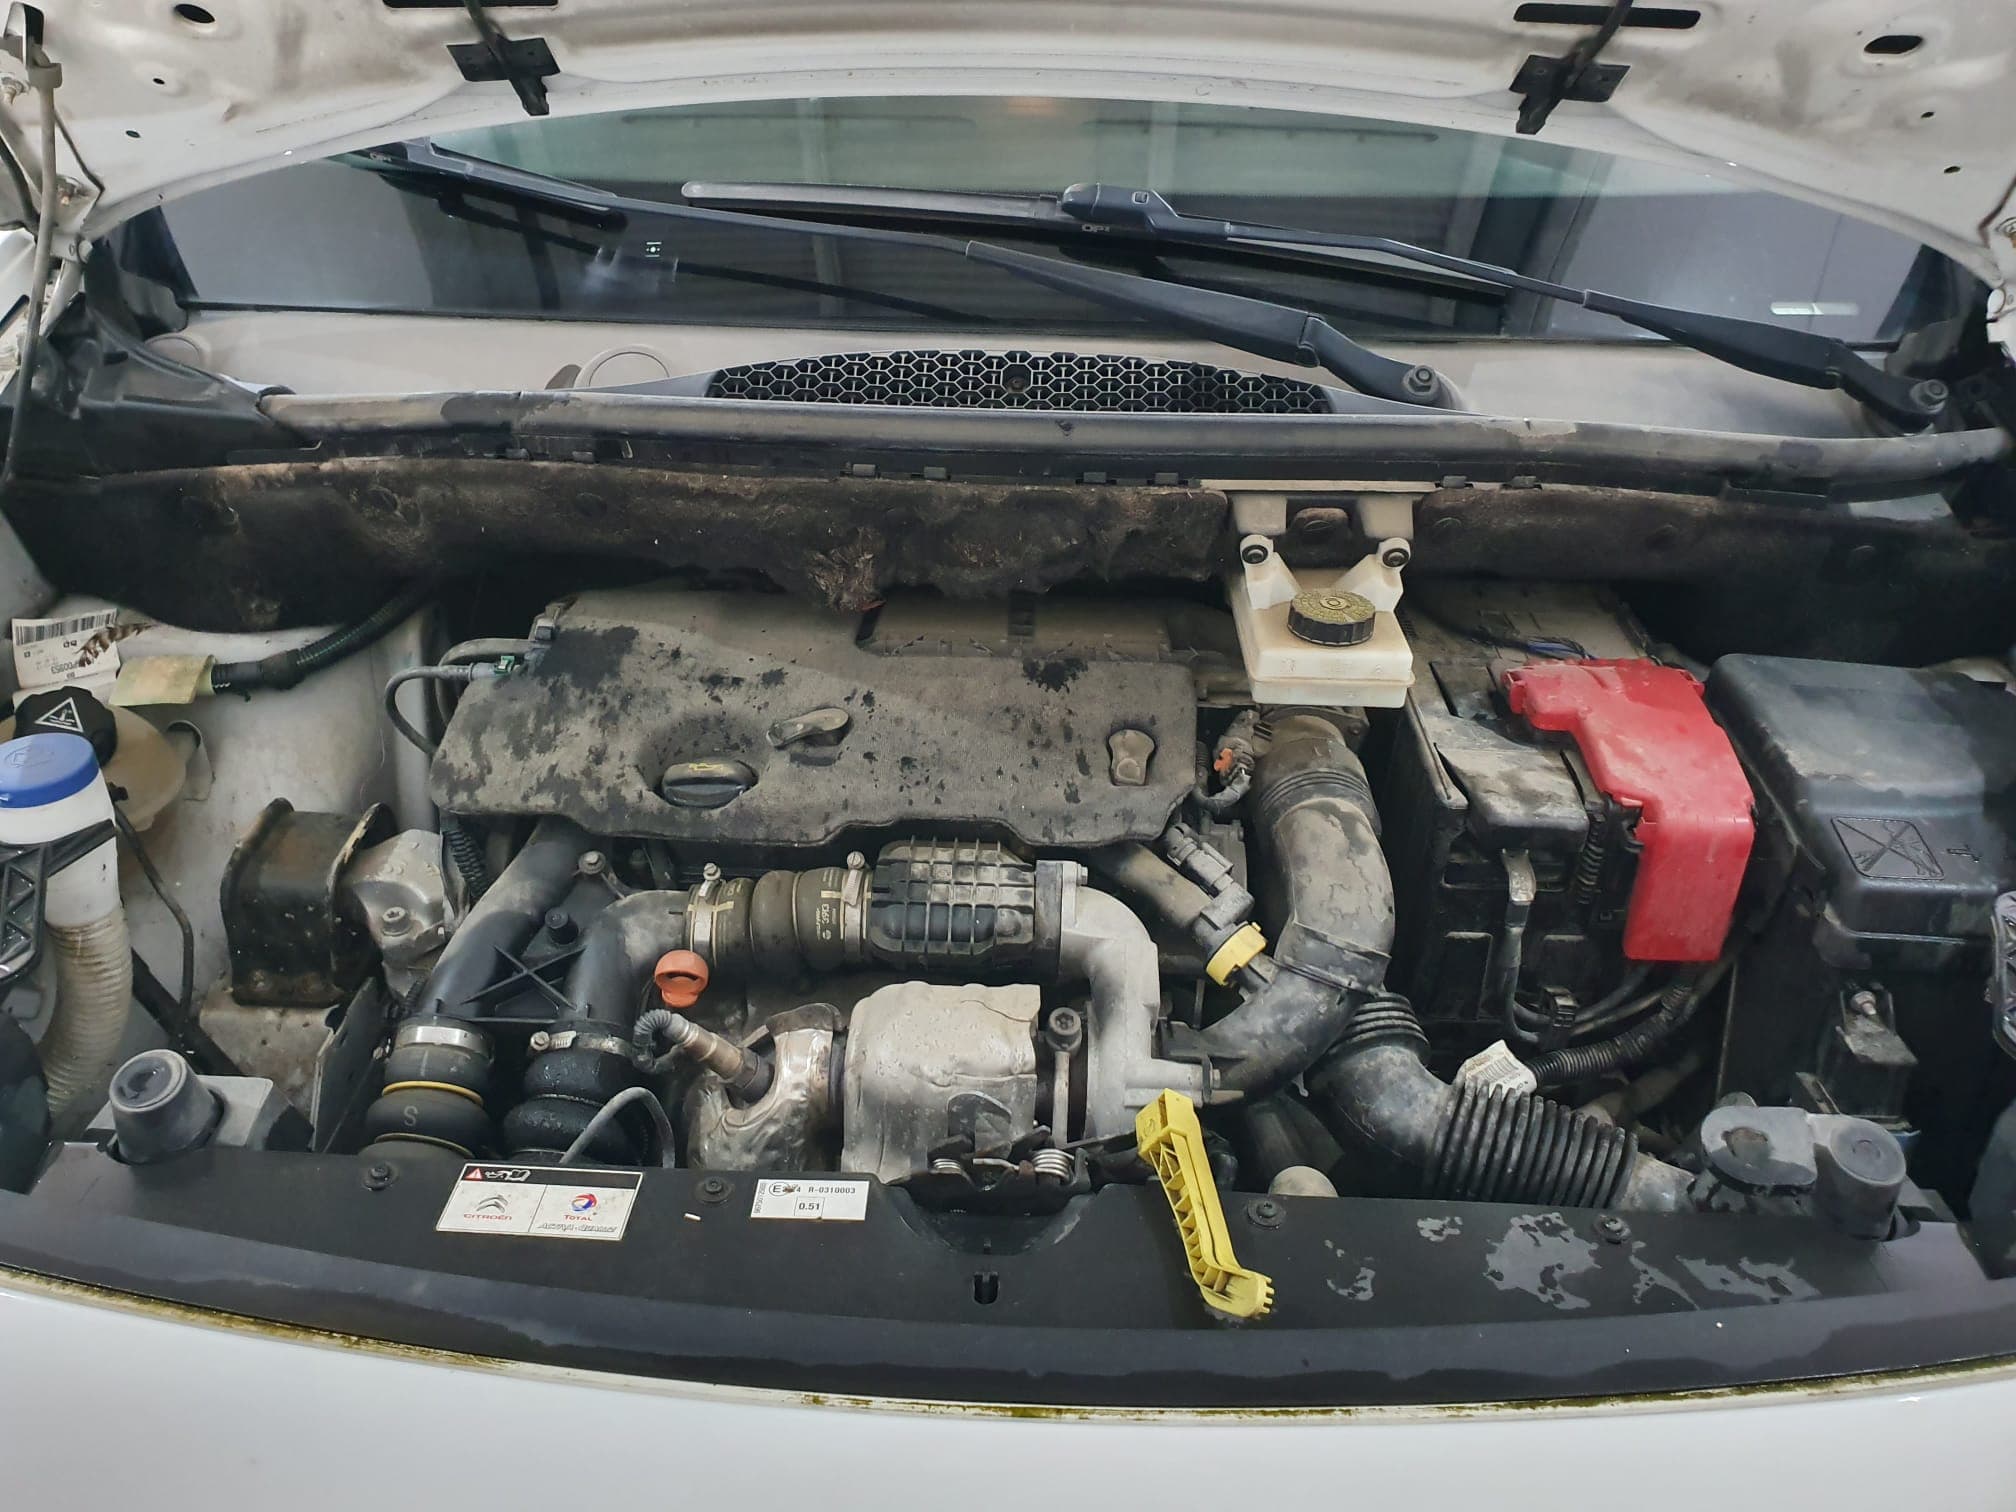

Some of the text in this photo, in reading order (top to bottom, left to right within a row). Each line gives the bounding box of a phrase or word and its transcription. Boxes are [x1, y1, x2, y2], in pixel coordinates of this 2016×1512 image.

[404, 1105, 418, 1127] S
[798, 1202, 820, 1211] 0.51
[563, 1214, 593, 1222] TOTAL
